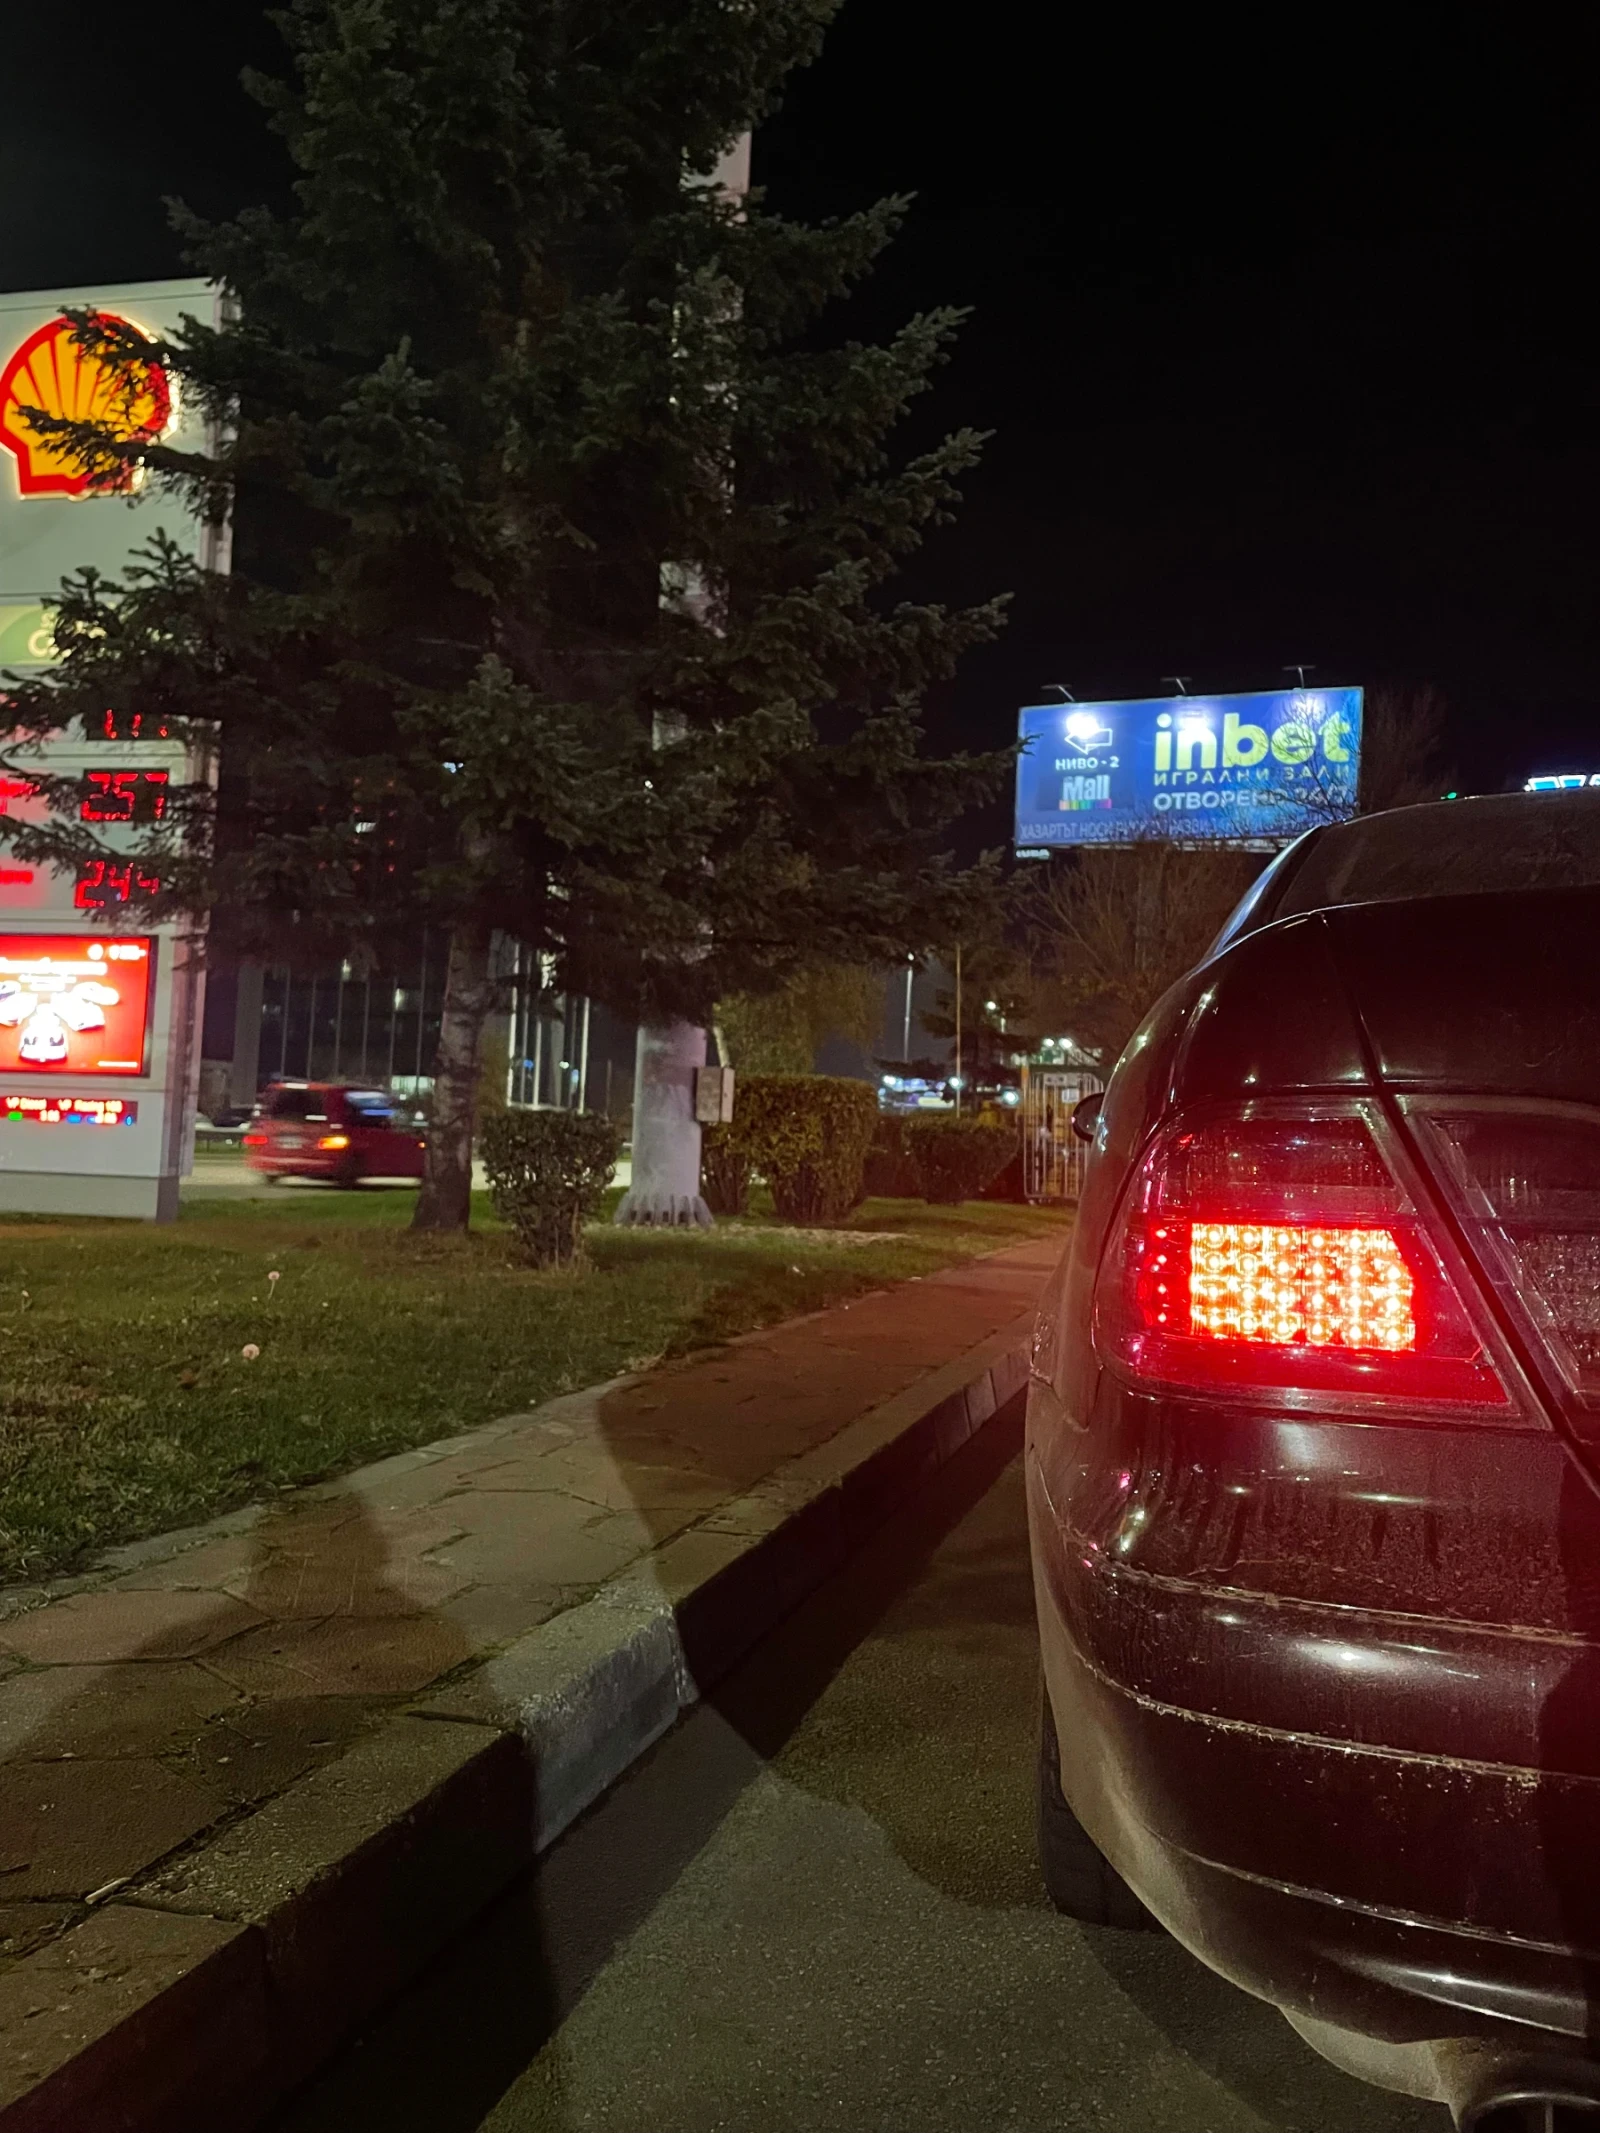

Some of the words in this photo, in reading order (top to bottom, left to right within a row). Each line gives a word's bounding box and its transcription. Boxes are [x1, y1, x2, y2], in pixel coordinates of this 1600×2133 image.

[1155, 711, 1350, 771] inbet
[1055, 757, 1098, 770] НИВО
[1109, 755, 1119, 768] 2
[1063, 774, 1110, 800] Mall
[1154, 767, 1269, 786] ИГРАЛНИ
[81, 772, 168, 820] 257
